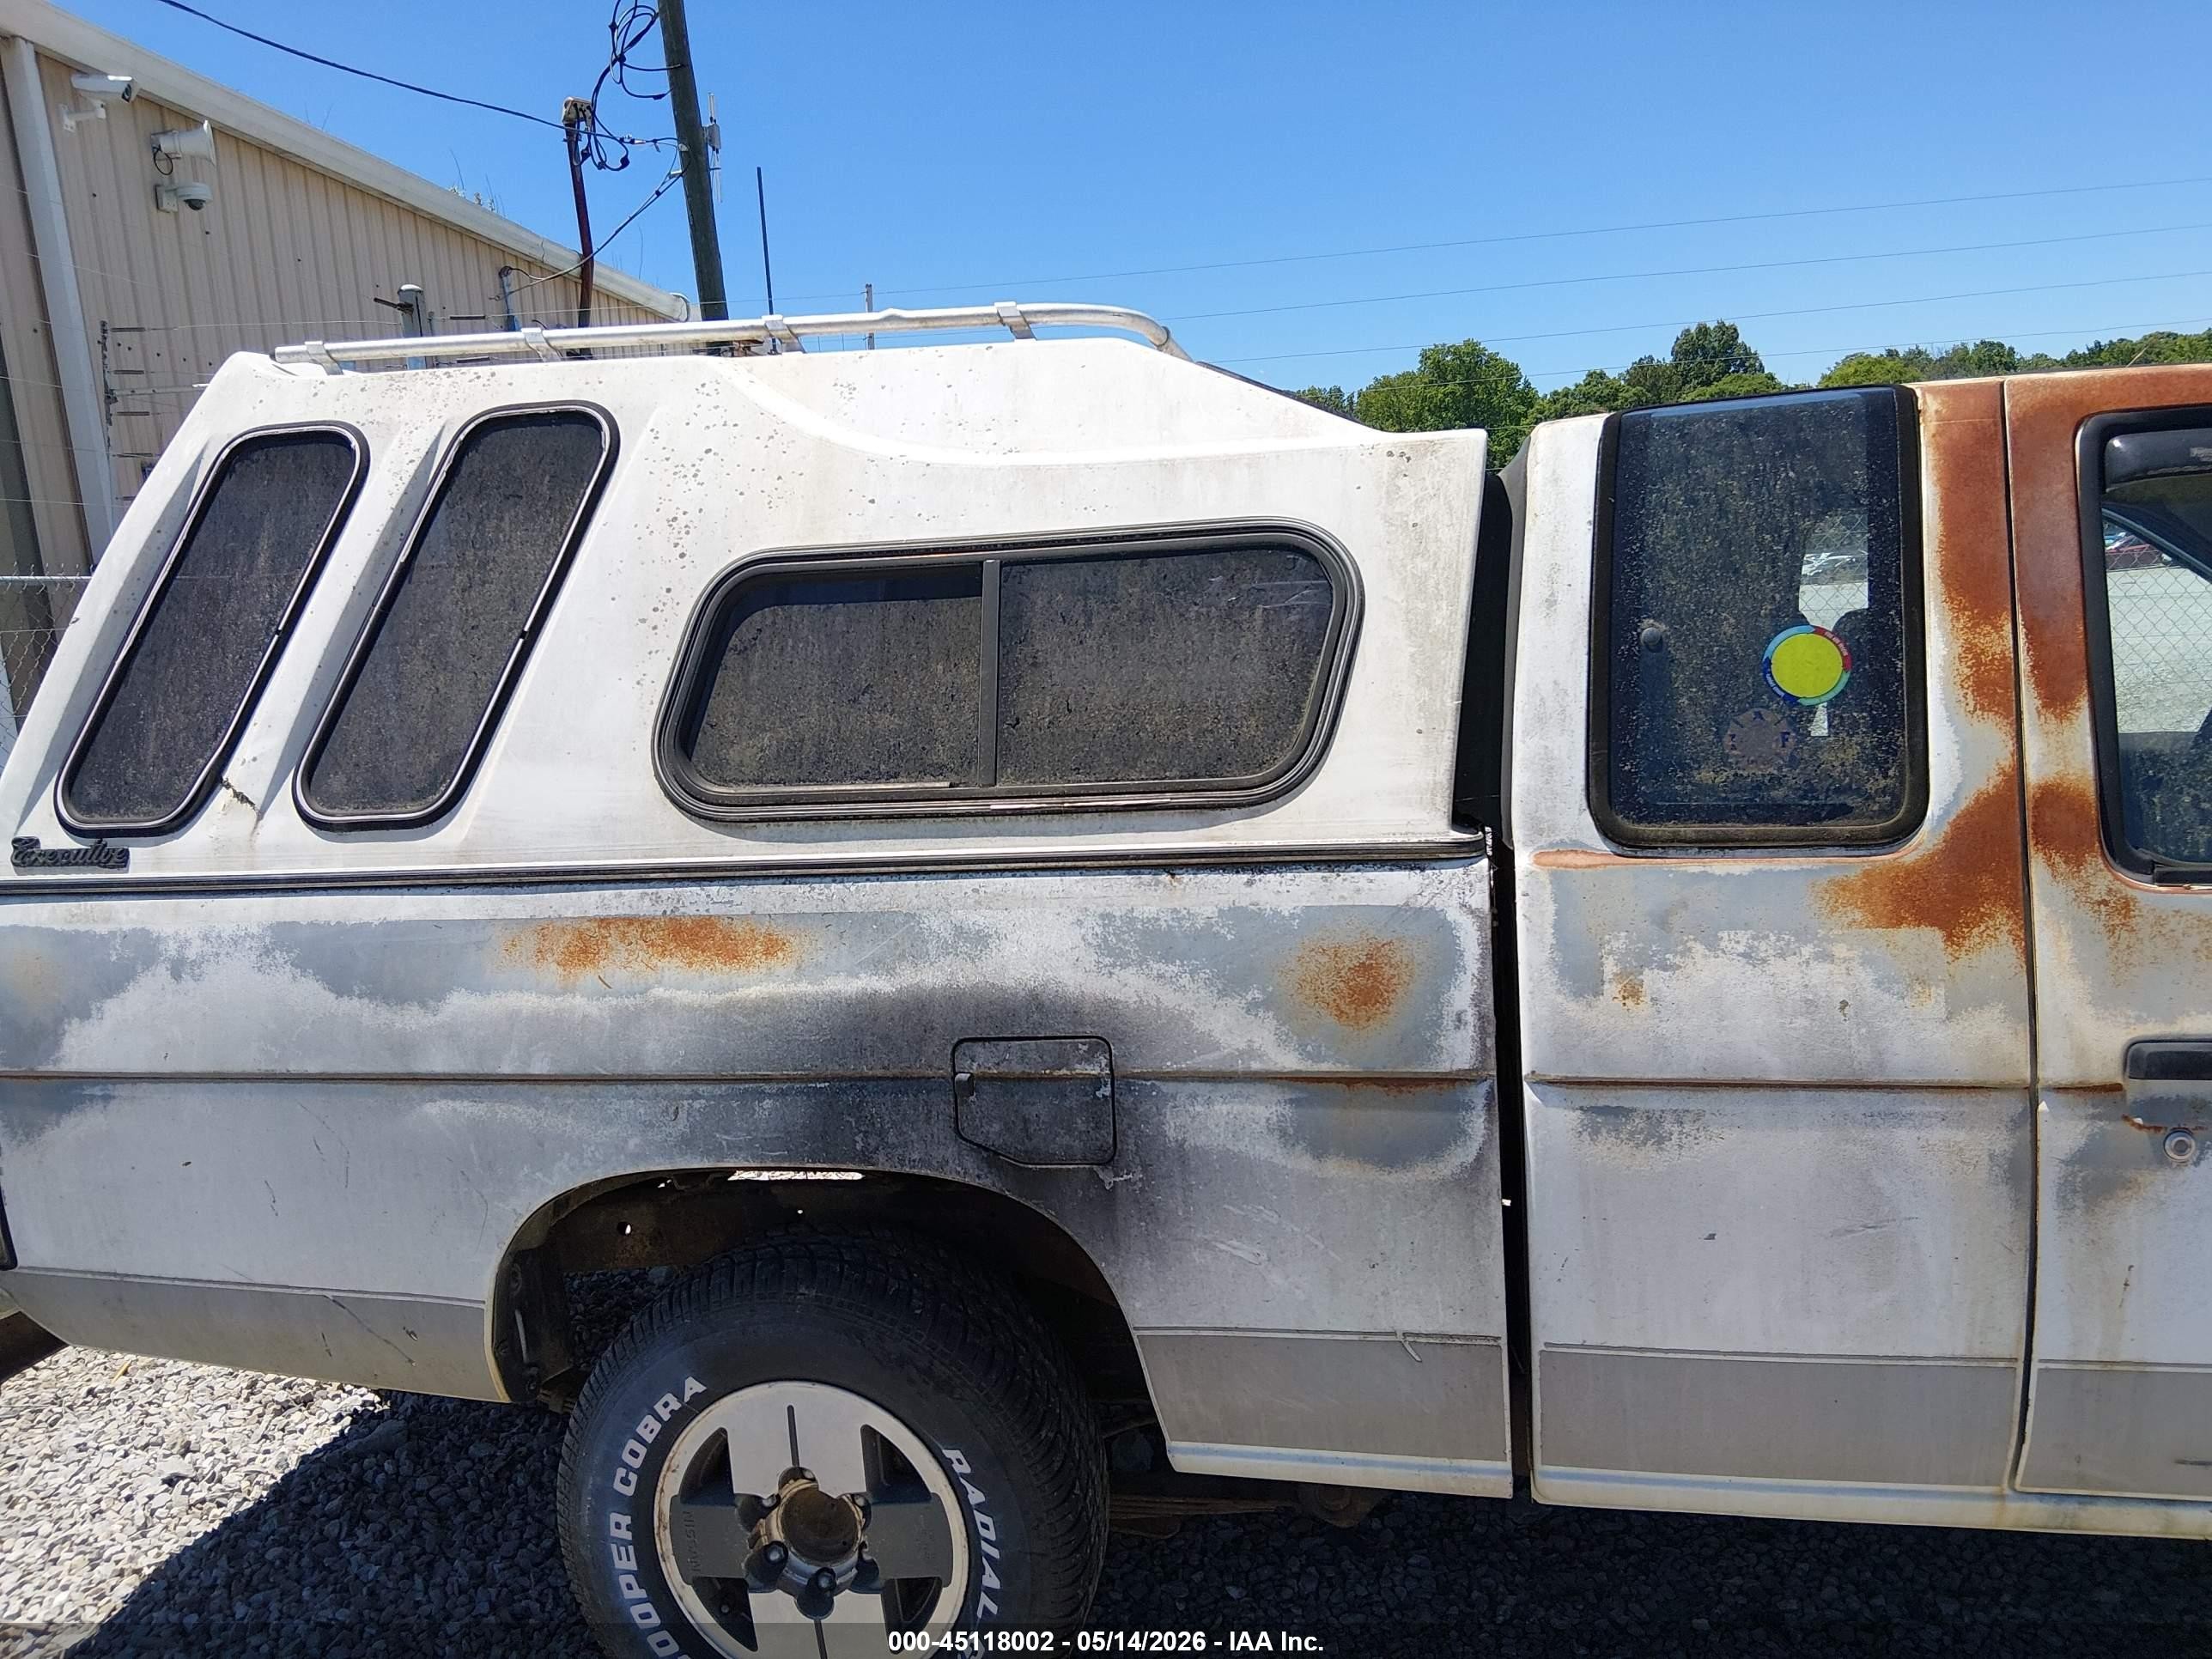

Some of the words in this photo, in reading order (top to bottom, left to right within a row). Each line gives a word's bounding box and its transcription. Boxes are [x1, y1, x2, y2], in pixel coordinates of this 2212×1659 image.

[11, 836, 130, 869] Executive
[613, 1376, 707, 1497] COBRA
[610, 1512, 690, 1659] OOPER
[942, 1449, 1001, 1620] RADIAL
